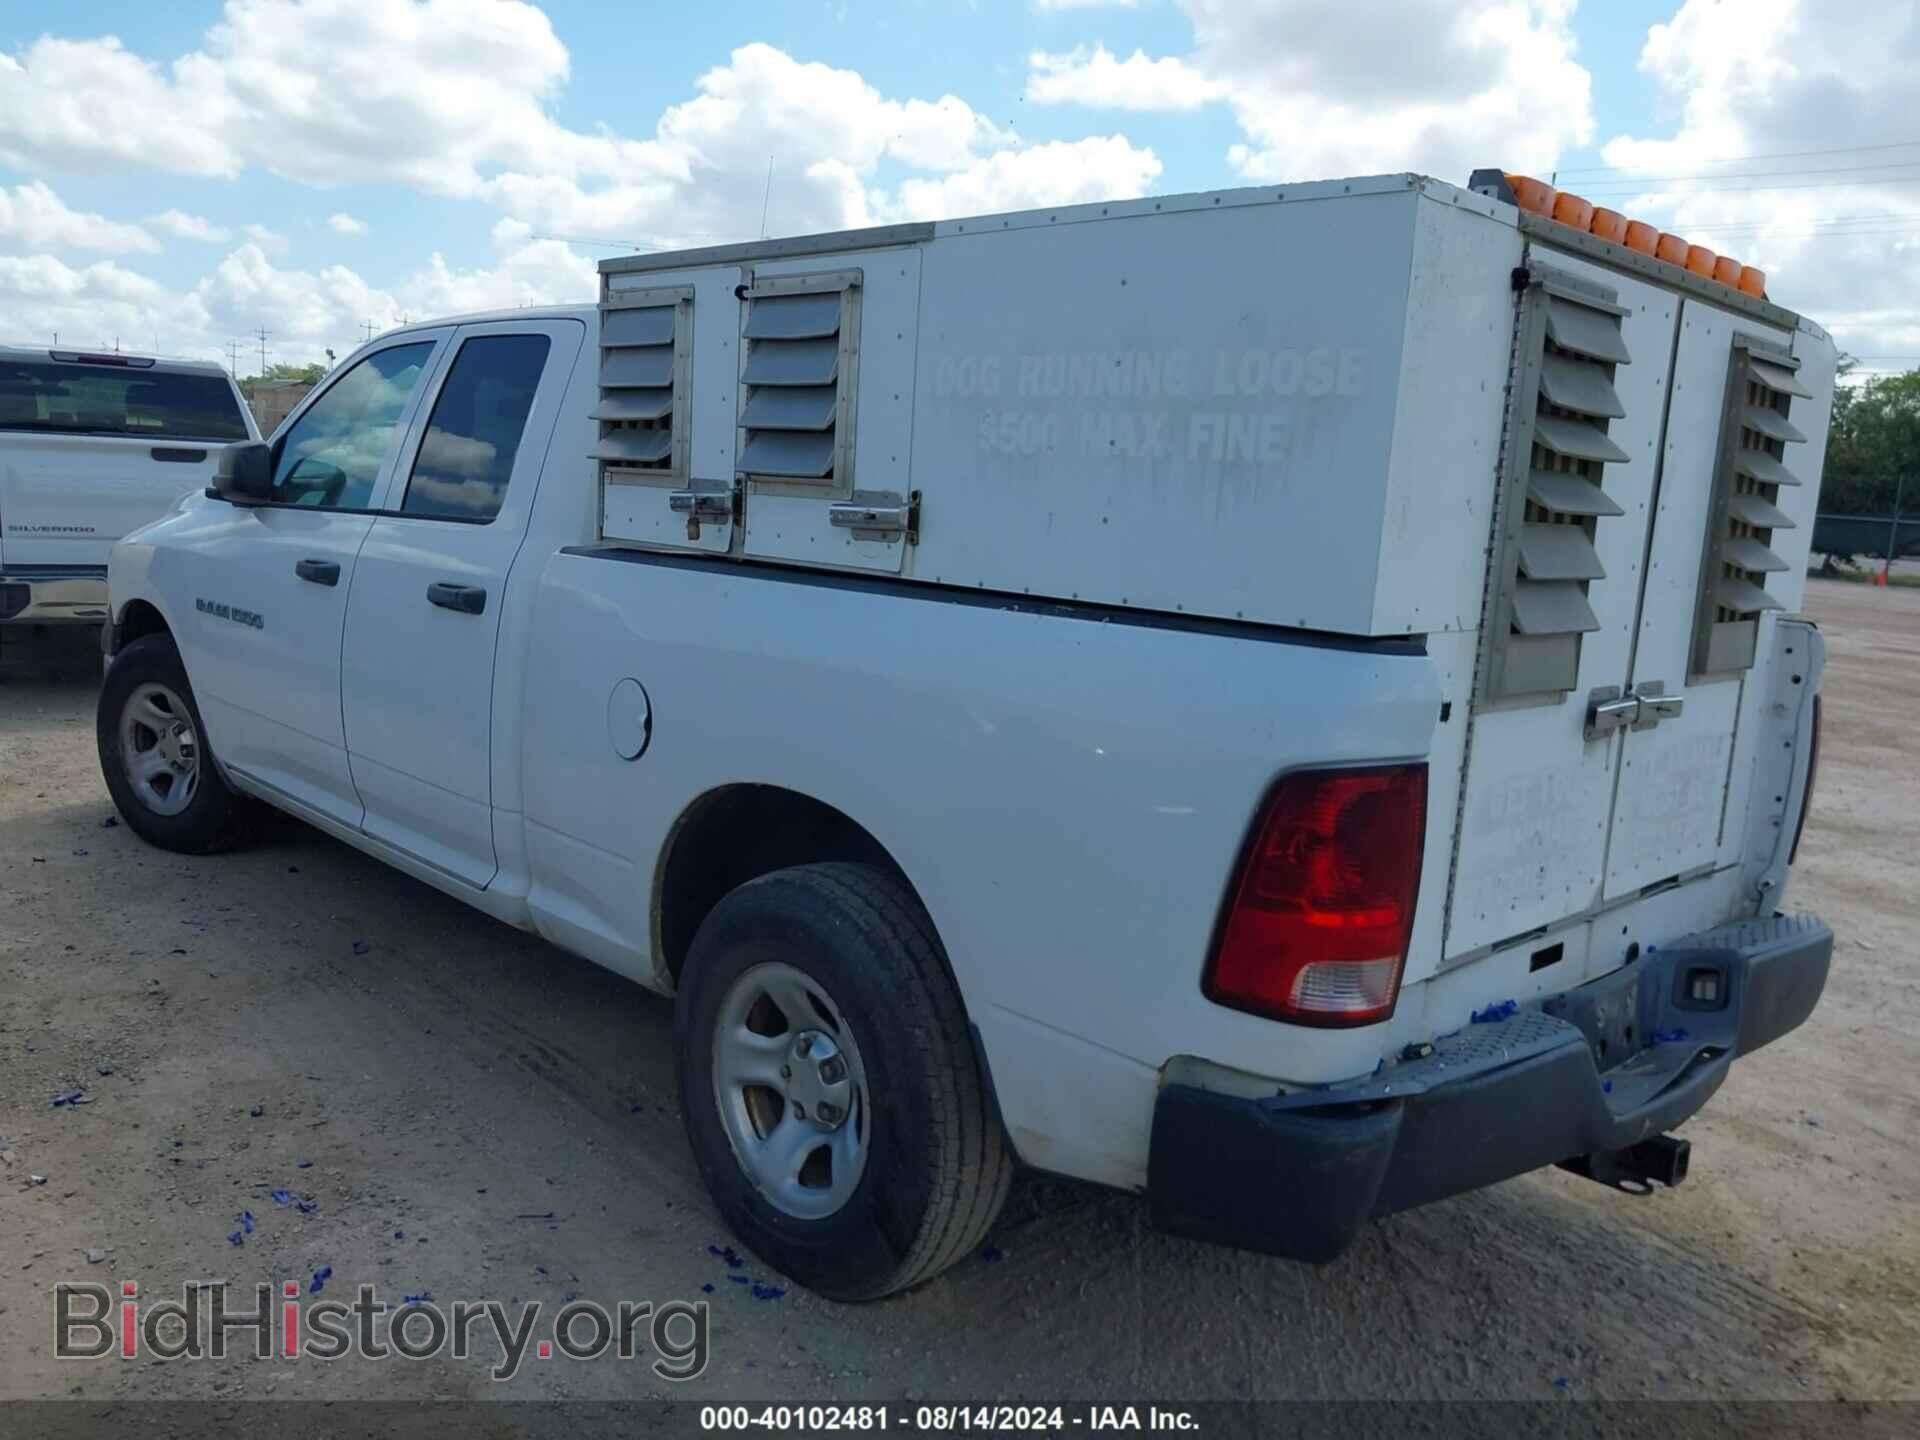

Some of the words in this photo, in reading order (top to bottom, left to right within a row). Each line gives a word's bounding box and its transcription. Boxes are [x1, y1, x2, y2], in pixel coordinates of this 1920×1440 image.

[1017, 350, 1189, 397] RUNNING
[1213, 346, 1368, 396] LOOSE
[1081, 411, 1173, 456] MAX
[1188, 414, 1290, 461] FINE
[8, 525, 95, 533] SILVERADO
